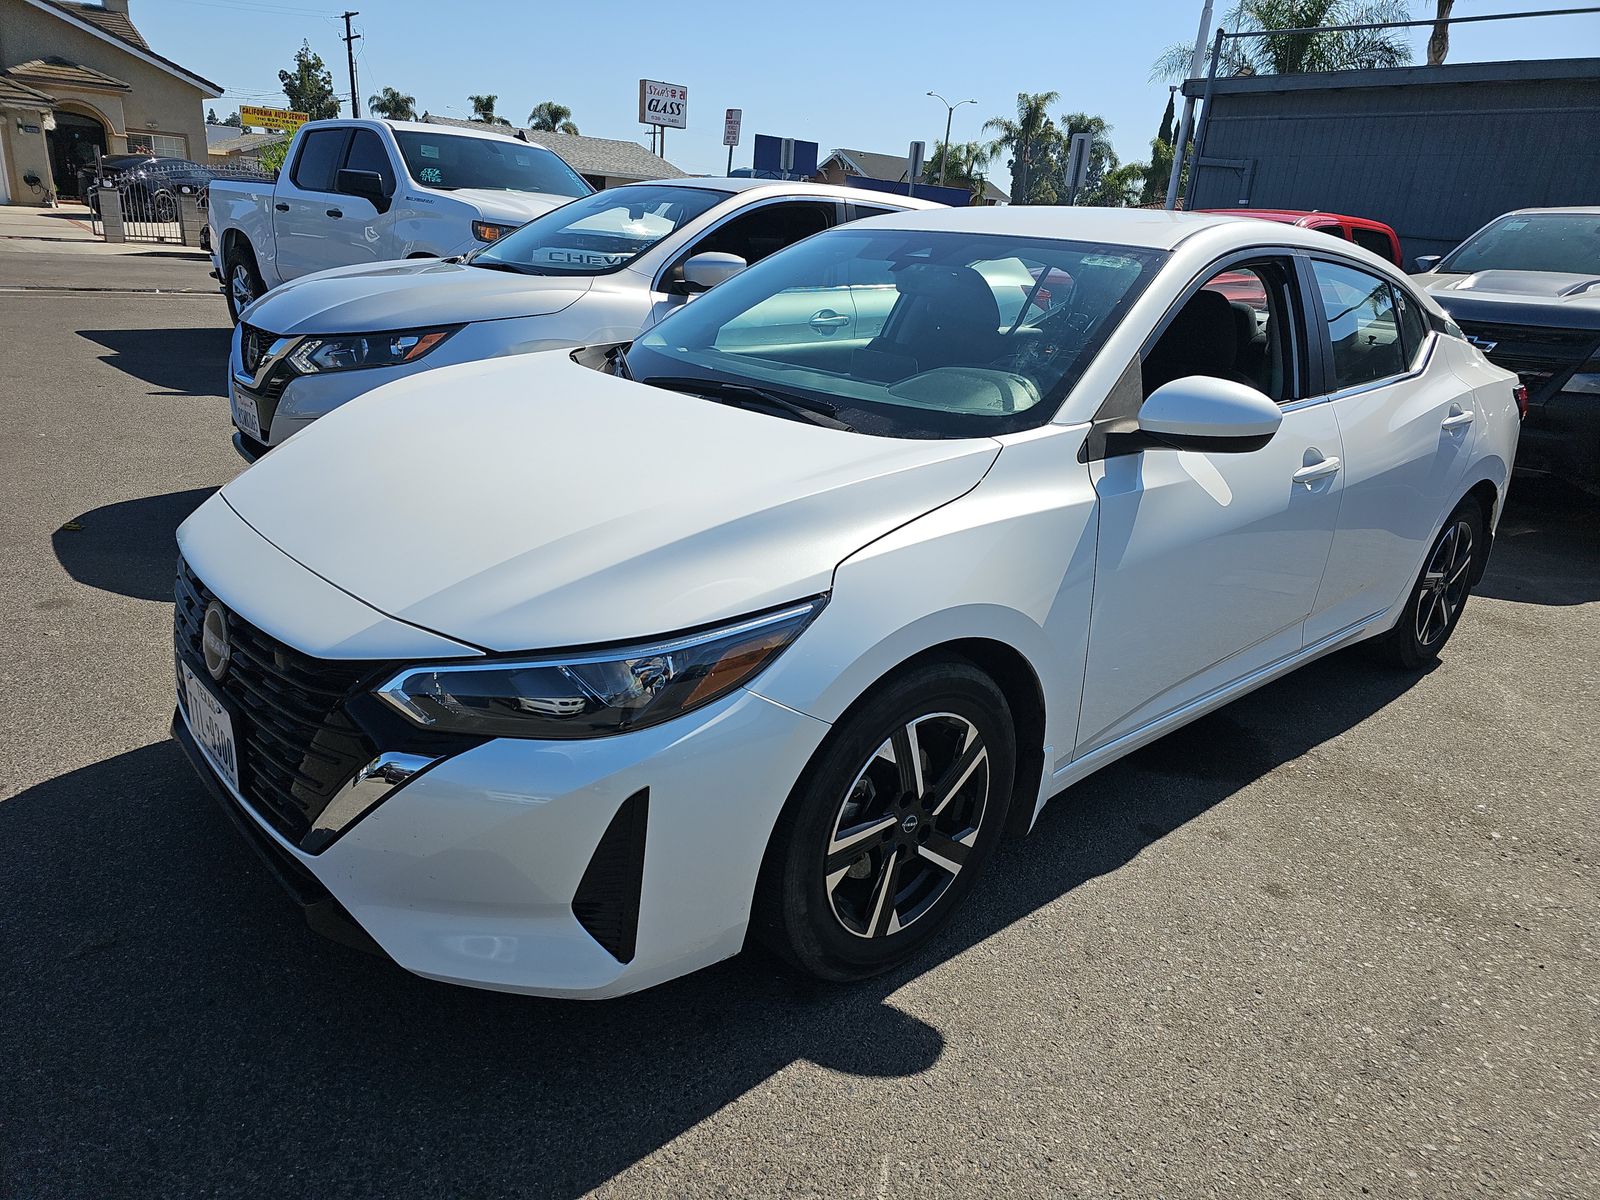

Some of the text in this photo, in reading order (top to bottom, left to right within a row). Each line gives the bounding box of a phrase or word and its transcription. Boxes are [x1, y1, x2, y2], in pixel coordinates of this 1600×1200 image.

[242, 107, 308, 121] CALIFORNIA AUTO SERVICE
[648, 98, 684, 116] GLASS
[195, 682, 217, 716] TEXAS
